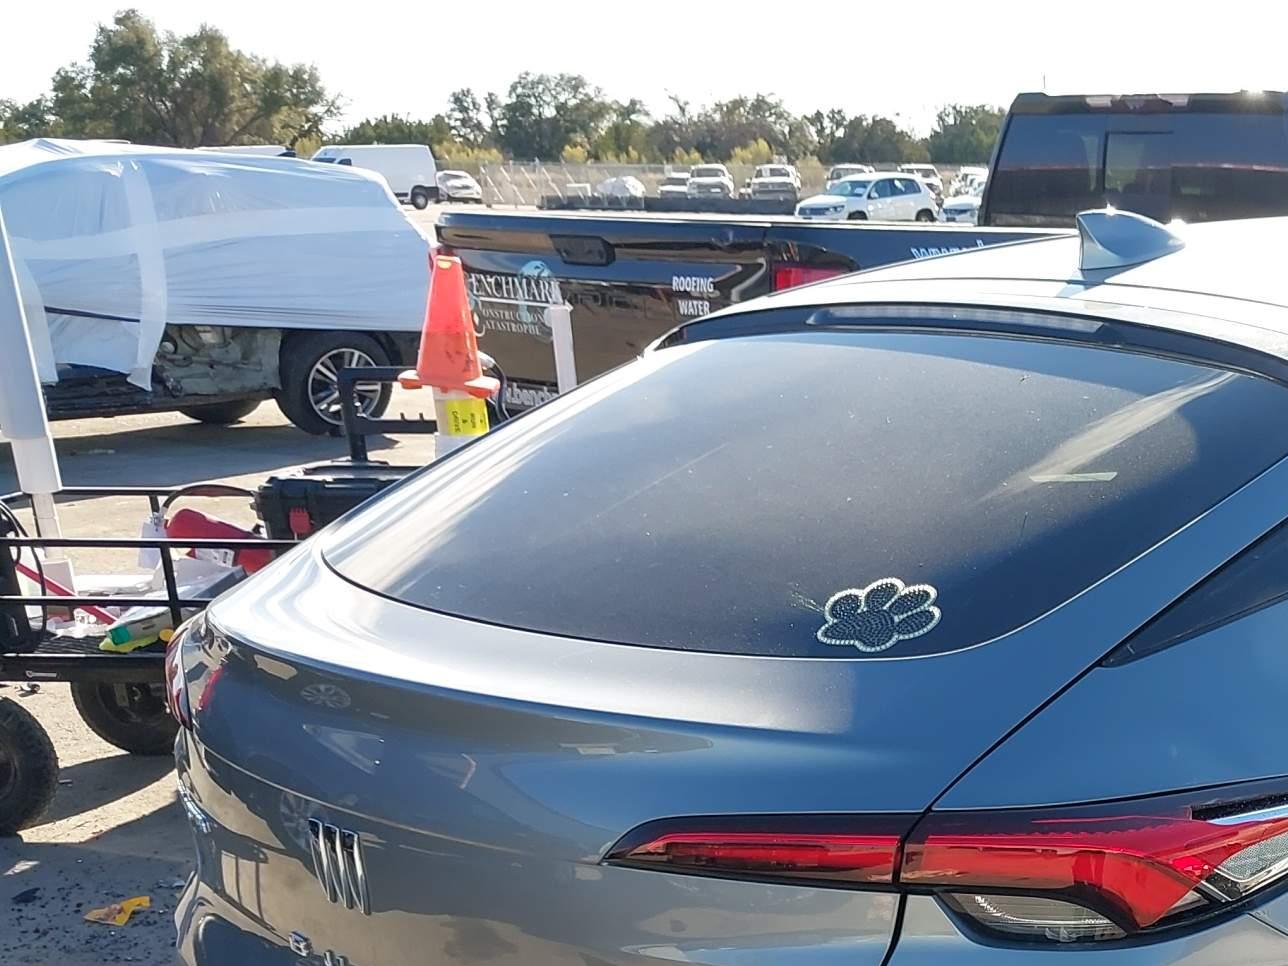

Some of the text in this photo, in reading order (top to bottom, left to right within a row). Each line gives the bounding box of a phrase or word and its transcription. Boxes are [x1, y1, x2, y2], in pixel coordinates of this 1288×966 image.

[467, 272, 561, 304] ENCHMAR
[672, 275, 714, 292] ROOFING
[678, 300, 710, 316] WATER
